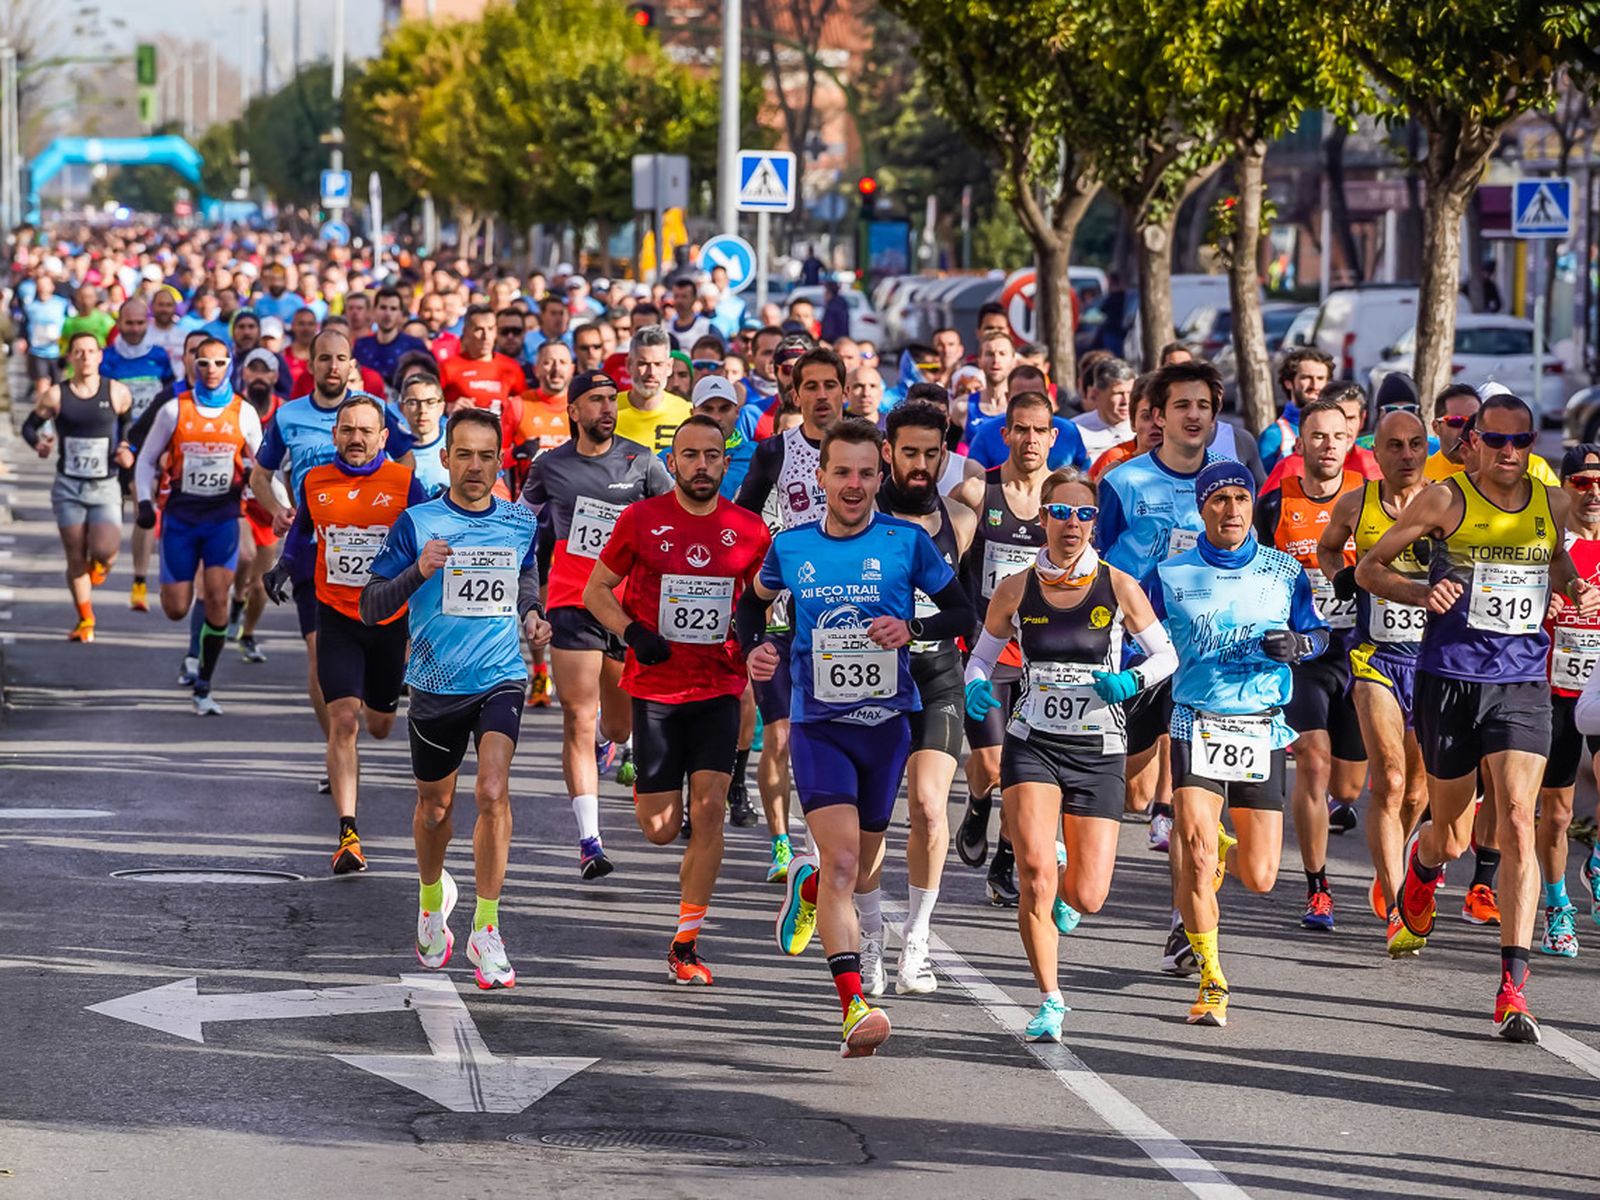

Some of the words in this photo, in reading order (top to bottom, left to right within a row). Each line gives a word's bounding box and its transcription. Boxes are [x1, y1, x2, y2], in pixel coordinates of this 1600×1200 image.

[73, 456, 99, 471] 579
[188, 473, 228, 488] 1256
[1200, 477, 1246, 502] WONG
[347, 537, 368, 545] 10K
[1006, 554, 1030, 563] 10K
[1469, 544, 1552, 563] TORREJÓN
[471, 557, 496, 566] 10K
[1501, 575, 1527, 585] 10K
[459, 579, 505, 602] 426
[687, 586, 713, 596] 10K
[801, 588, 814, 599] XII
[815, 585, 844, 597] ECO
[846, 584, 881, 596] TRAIL
[824, 596, 835, 604] DE
[849, 595, 881, 603] VIENTOS
[1486, 596, 1533, 620] 319
[674, 607, 719, 631] 823
[1382, 609, 1427, 630] 633
[1238, 623, 1256, 640] DE
[841, 641, 869, 650] 10K
[830, 663, 882, 687] 638
[1055, 674, 1082, 683] 10K
[1044, 696, 1091, 720] 697
[1220, 725, 1246, 734] 10K
[1206, 742, 1255, 768] 780
